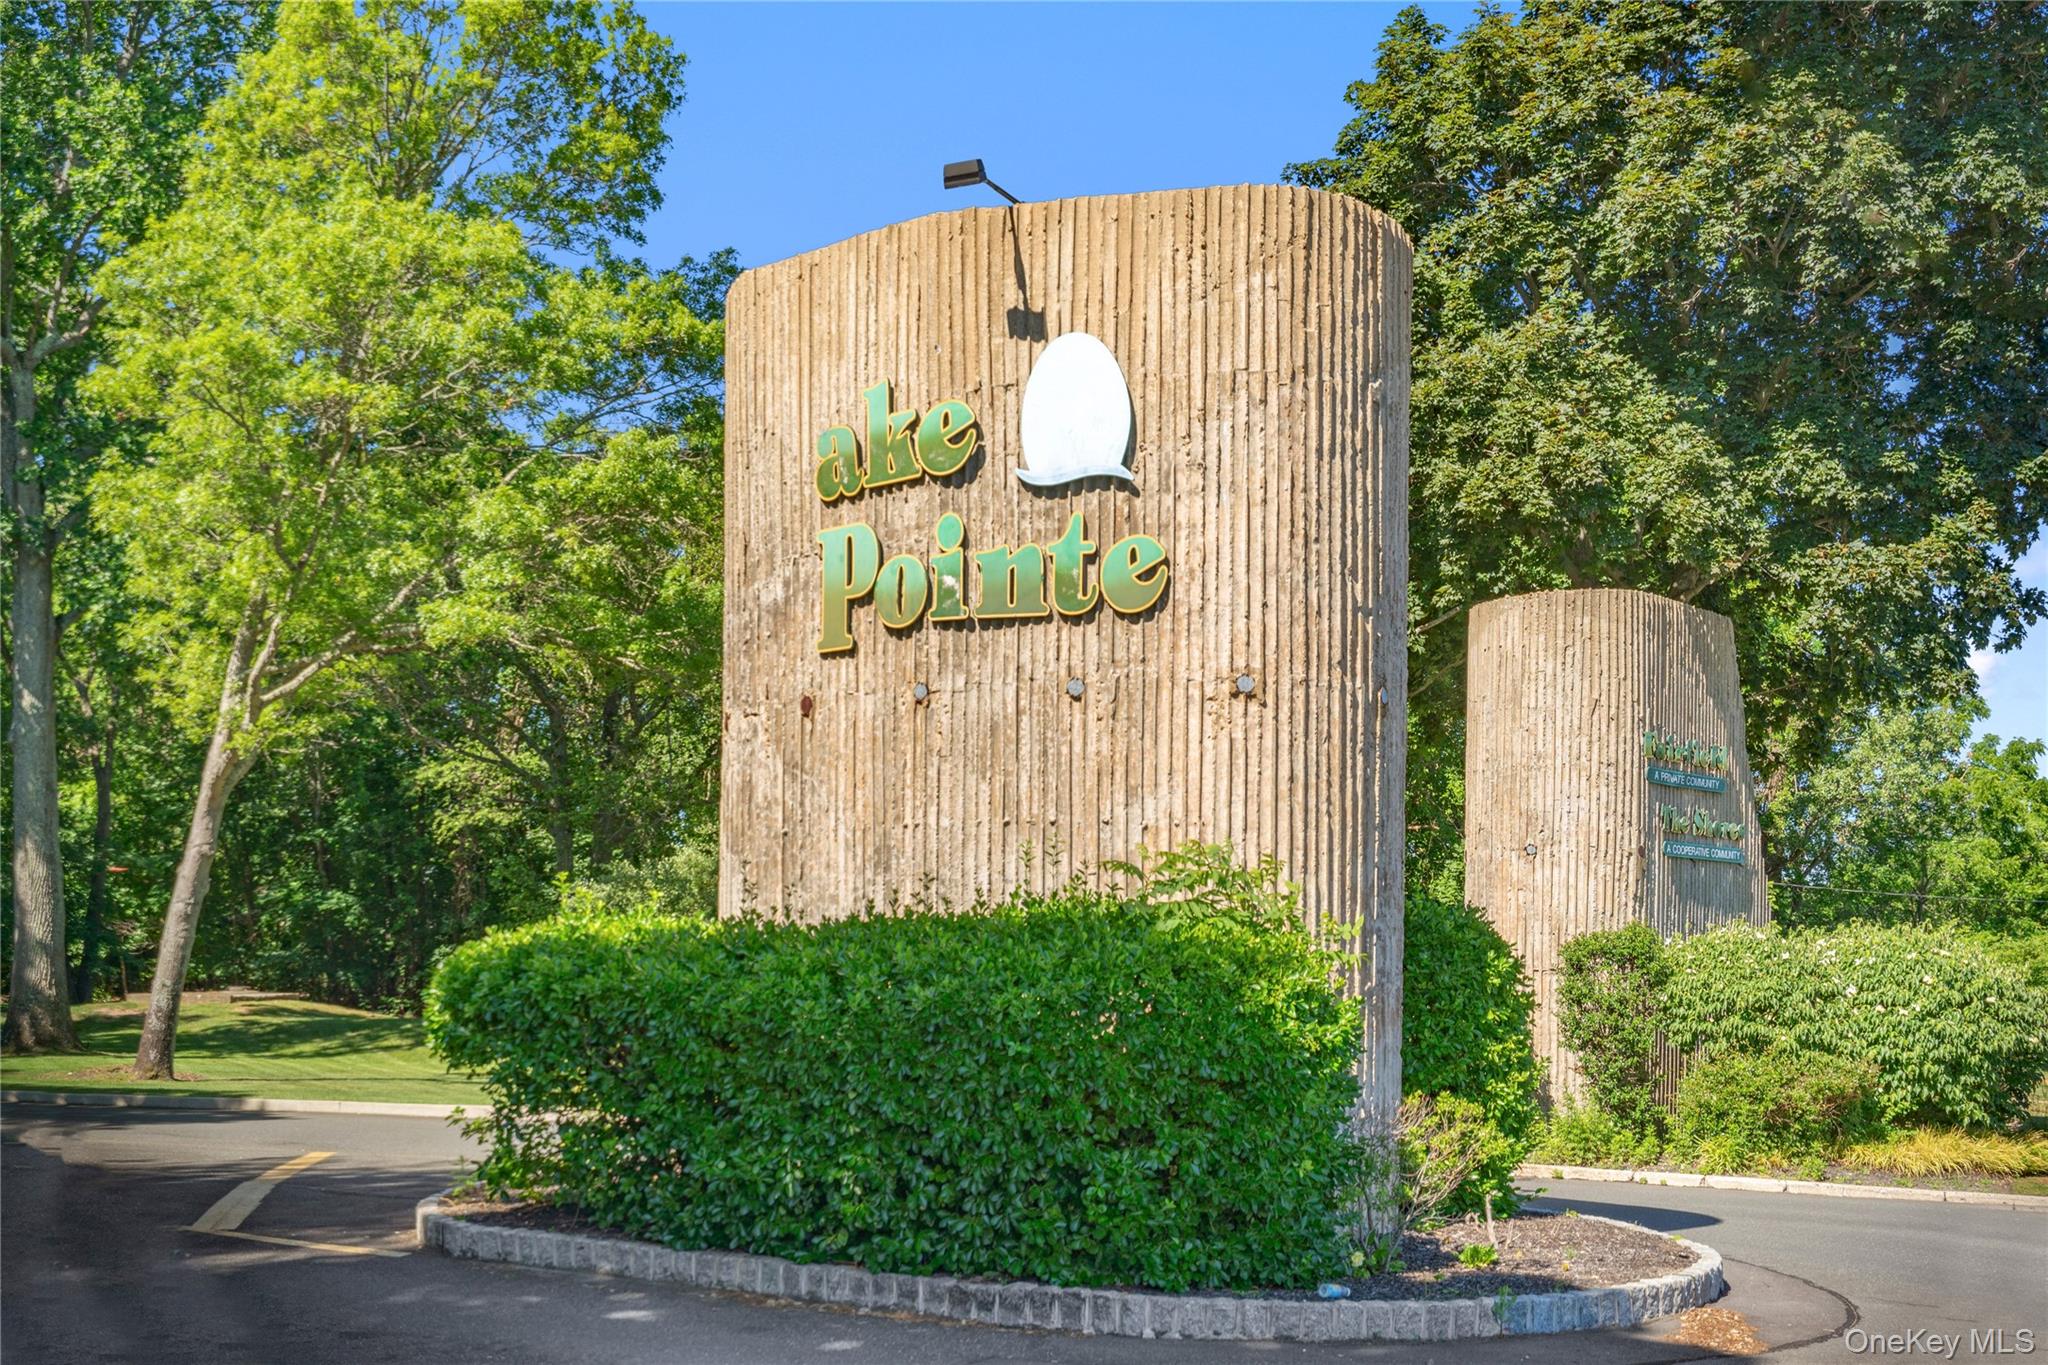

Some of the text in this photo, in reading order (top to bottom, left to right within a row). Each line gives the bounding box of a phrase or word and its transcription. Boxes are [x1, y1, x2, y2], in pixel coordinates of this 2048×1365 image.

[816, 379, 977, 502] ake
[816, 512, 1169, 654] Pointe
[1643, 731, 1728, 770] Fairfield
[1654, 771, 1720, 789] A PRIVATE COMMUNITY
[1661, 803, 1690, 834] The
[1666, 844, 1741, 861] A COOPERATIVE COMMUNITY
